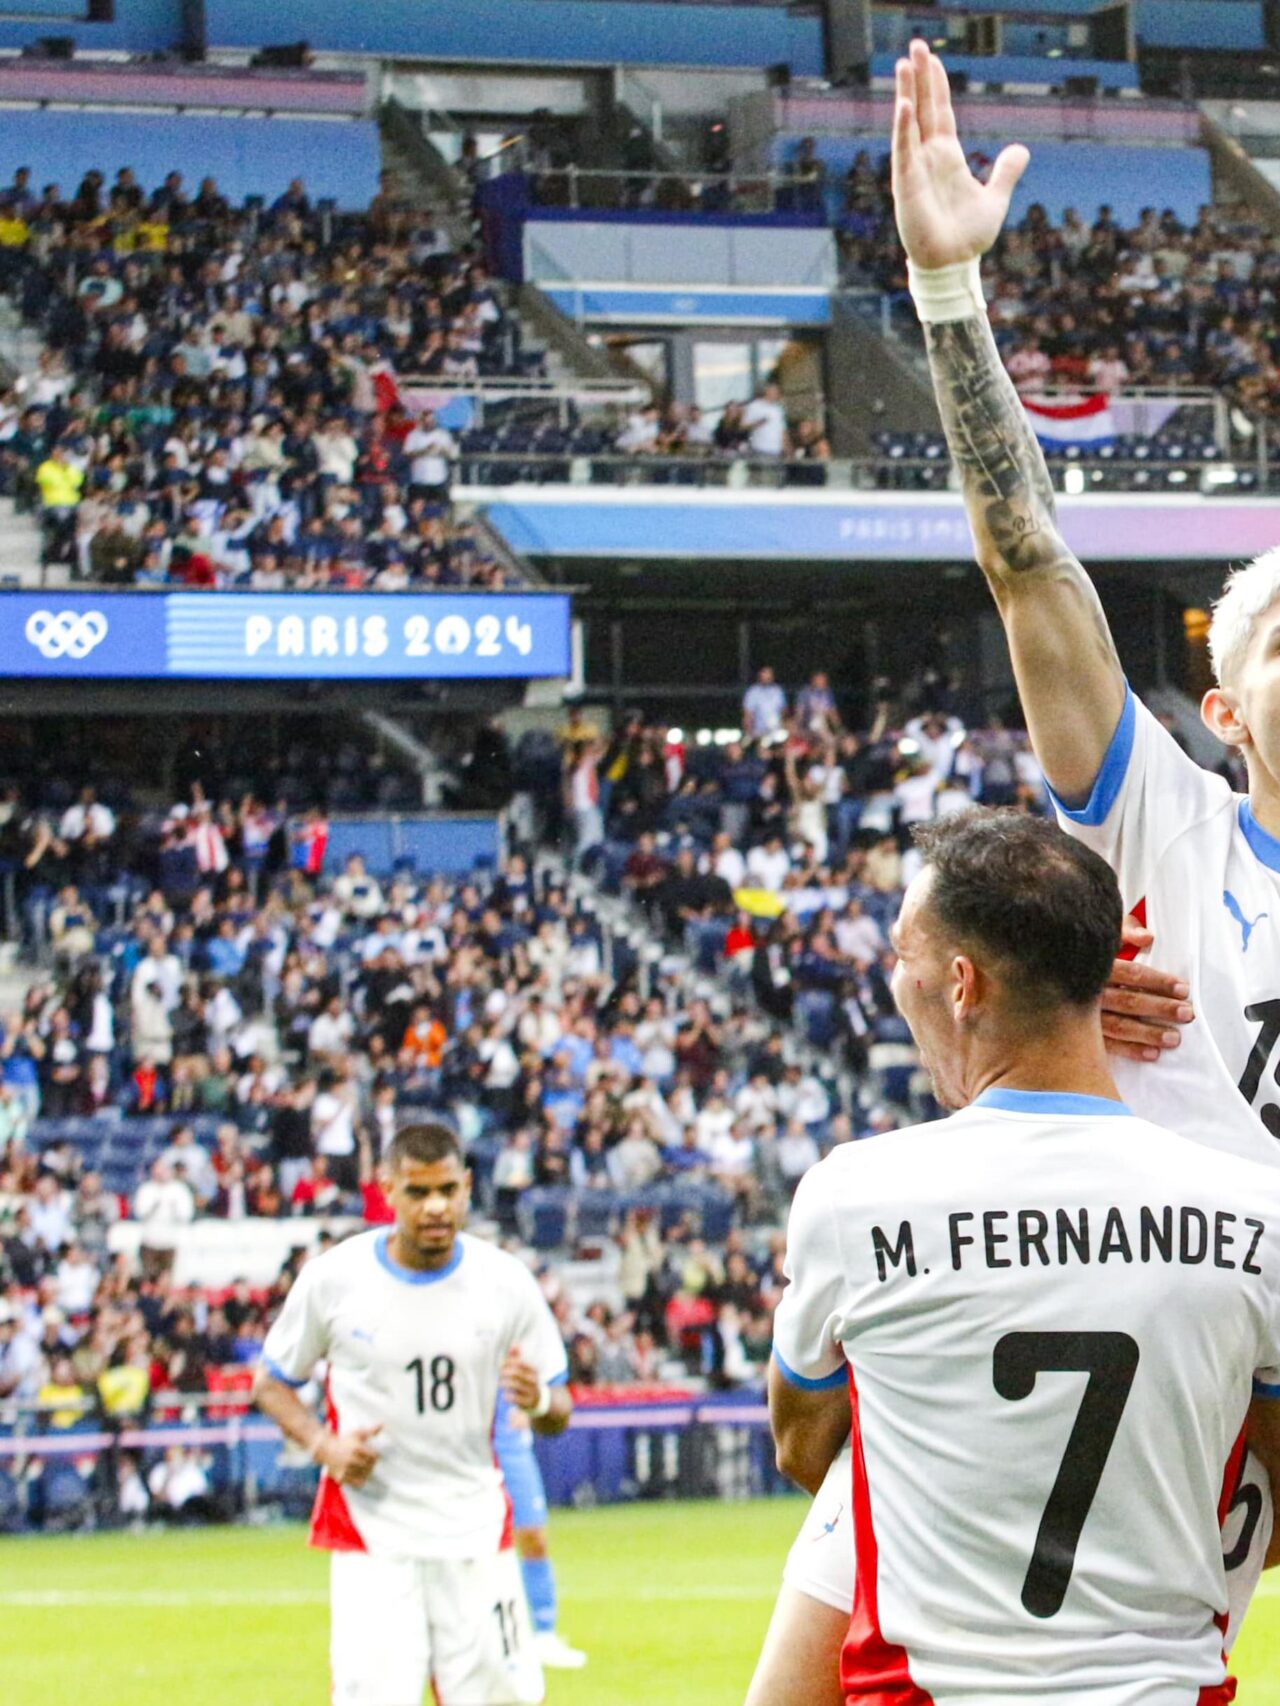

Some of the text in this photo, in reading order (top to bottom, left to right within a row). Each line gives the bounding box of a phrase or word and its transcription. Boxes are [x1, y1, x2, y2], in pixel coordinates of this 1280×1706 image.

[245, 614, 532, 657] PARIS 2024
[871, 1205, 1264, 1282] M. FERNANDEZ
[405, 1354, 455, 1415] 18
[993, 1331, 1140, 1618] 7
